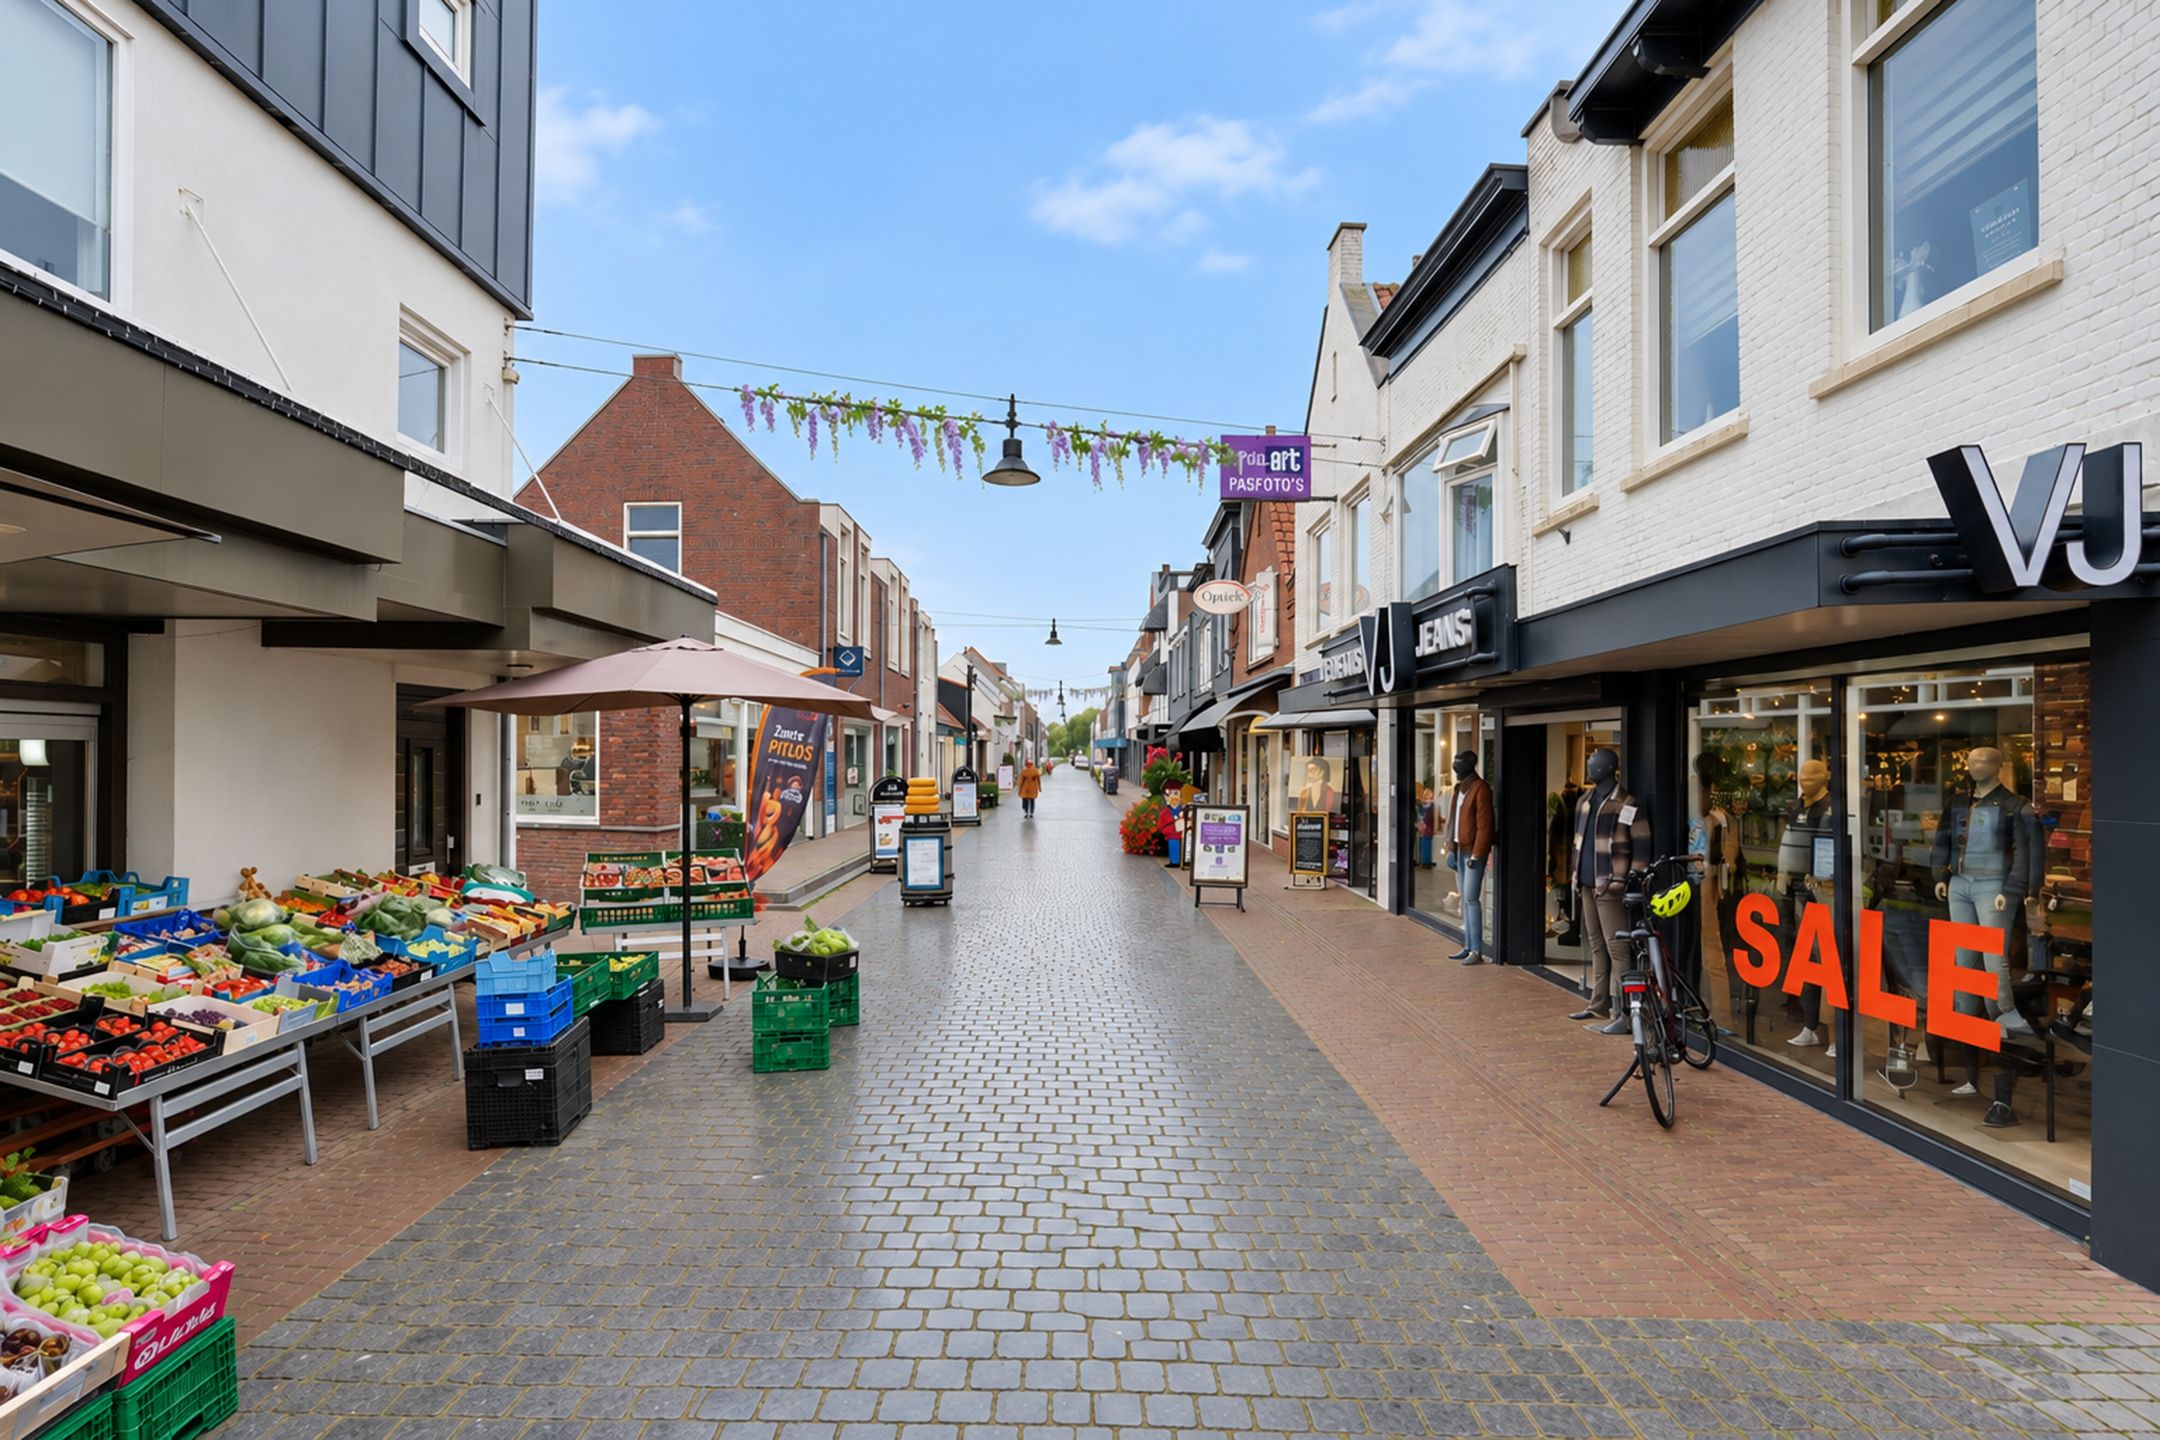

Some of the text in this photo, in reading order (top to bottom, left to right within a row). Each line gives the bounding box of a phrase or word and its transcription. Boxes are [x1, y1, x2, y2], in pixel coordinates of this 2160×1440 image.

[1229, 477, 1304, 492] PASFOTO'S
[1928, 442, 2143, 593] VJ
[1359, 602, 1403, 696] VJ
[1415, 608, 1472, 658] JEANS
[768, 739, 814, 762] PITLOS
[1733, 893, 2004, 1052] SALE
